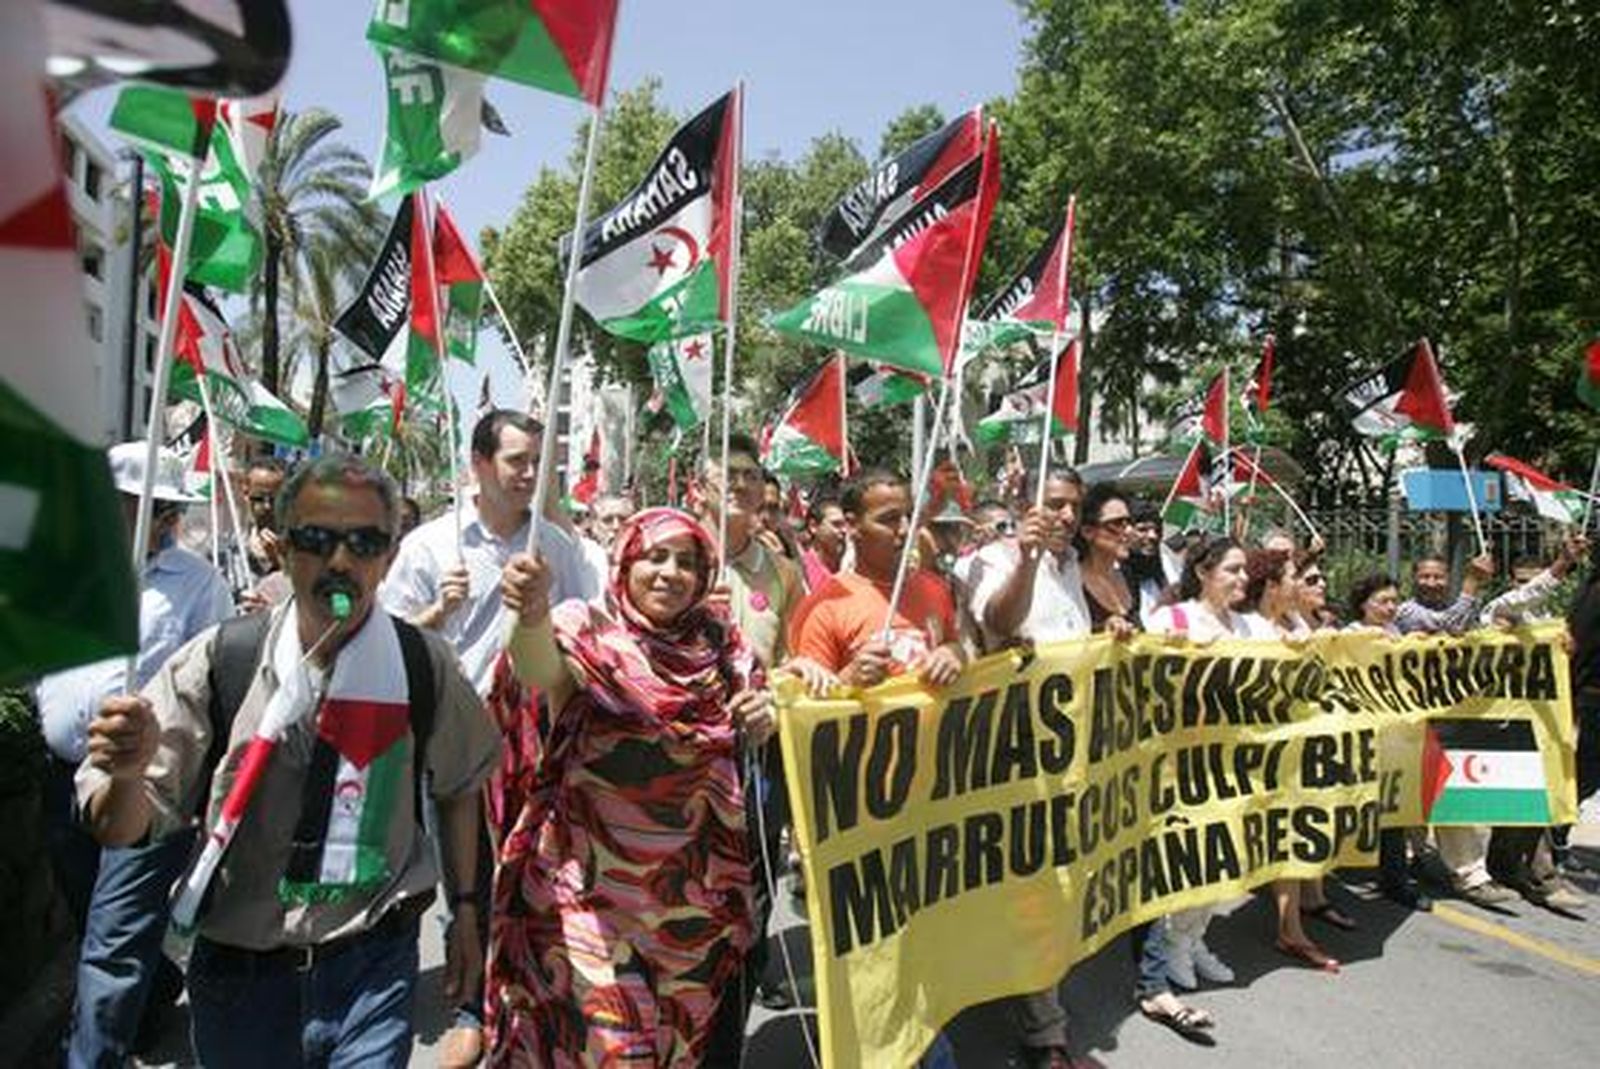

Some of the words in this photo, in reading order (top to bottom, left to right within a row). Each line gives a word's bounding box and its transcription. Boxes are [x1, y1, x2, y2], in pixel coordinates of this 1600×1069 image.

[810, 706, 920, 844] NO
[931, 653, 1076, 800] MÁS
[829, 765, 1140, 958] MARRUECOS
[1082, 815, 1240, 939] ESPAÑA
